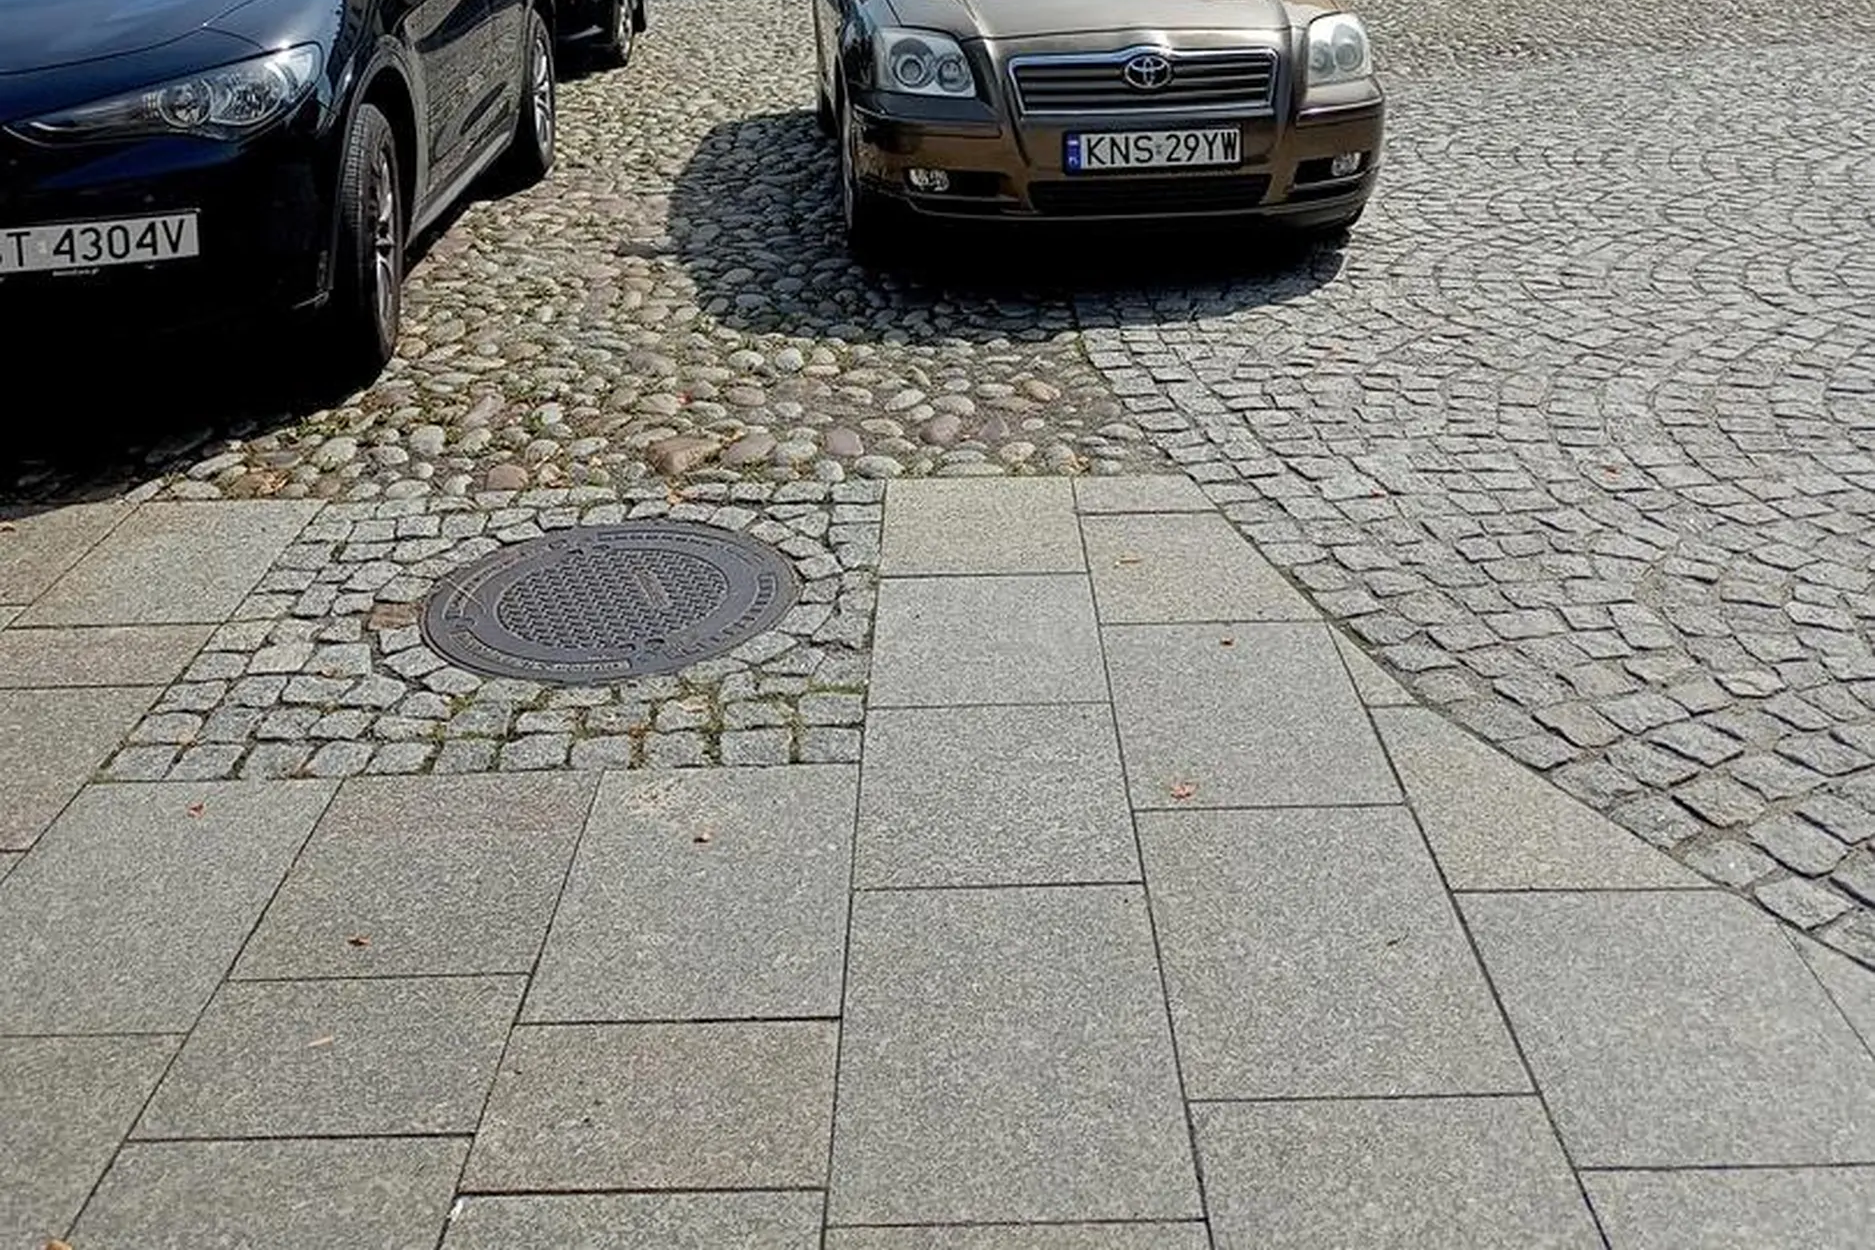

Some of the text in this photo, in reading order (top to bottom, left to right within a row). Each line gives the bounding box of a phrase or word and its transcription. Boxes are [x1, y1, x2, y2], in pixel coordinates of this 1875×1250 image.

[1087, 131, 1237, 165] KNS 29YW
[0, 218, 185, 267] T 4304V
